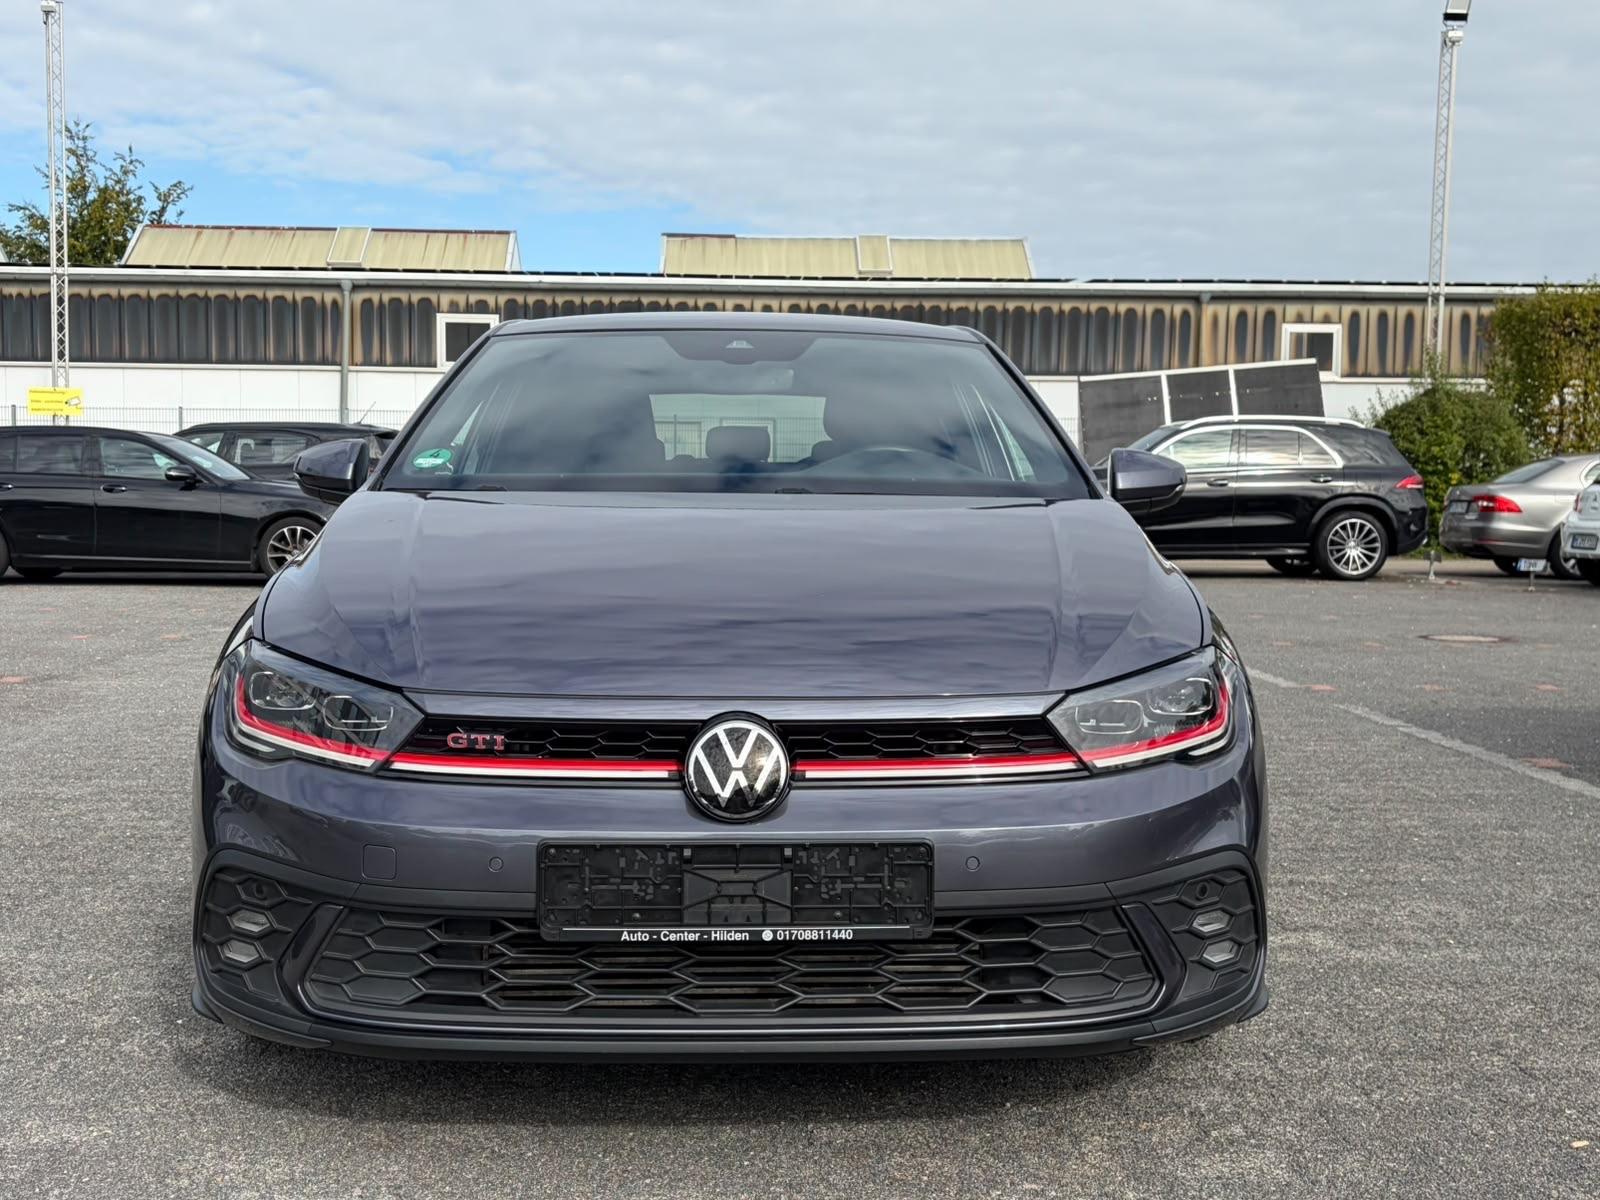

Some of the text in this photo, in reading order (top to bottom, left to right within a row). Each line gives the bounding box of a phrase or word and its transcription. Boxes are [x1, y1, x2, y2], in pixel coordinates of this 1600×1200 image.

[446, 732, 505, 751] GTI
[692, 724, 783, 812] VW
[620, 930, 650, 942] Auto
[660, 930, 701, 942] Center
[711, 930, 750, 942] Hilden
[776, 929, 853, 941] 01708811440
